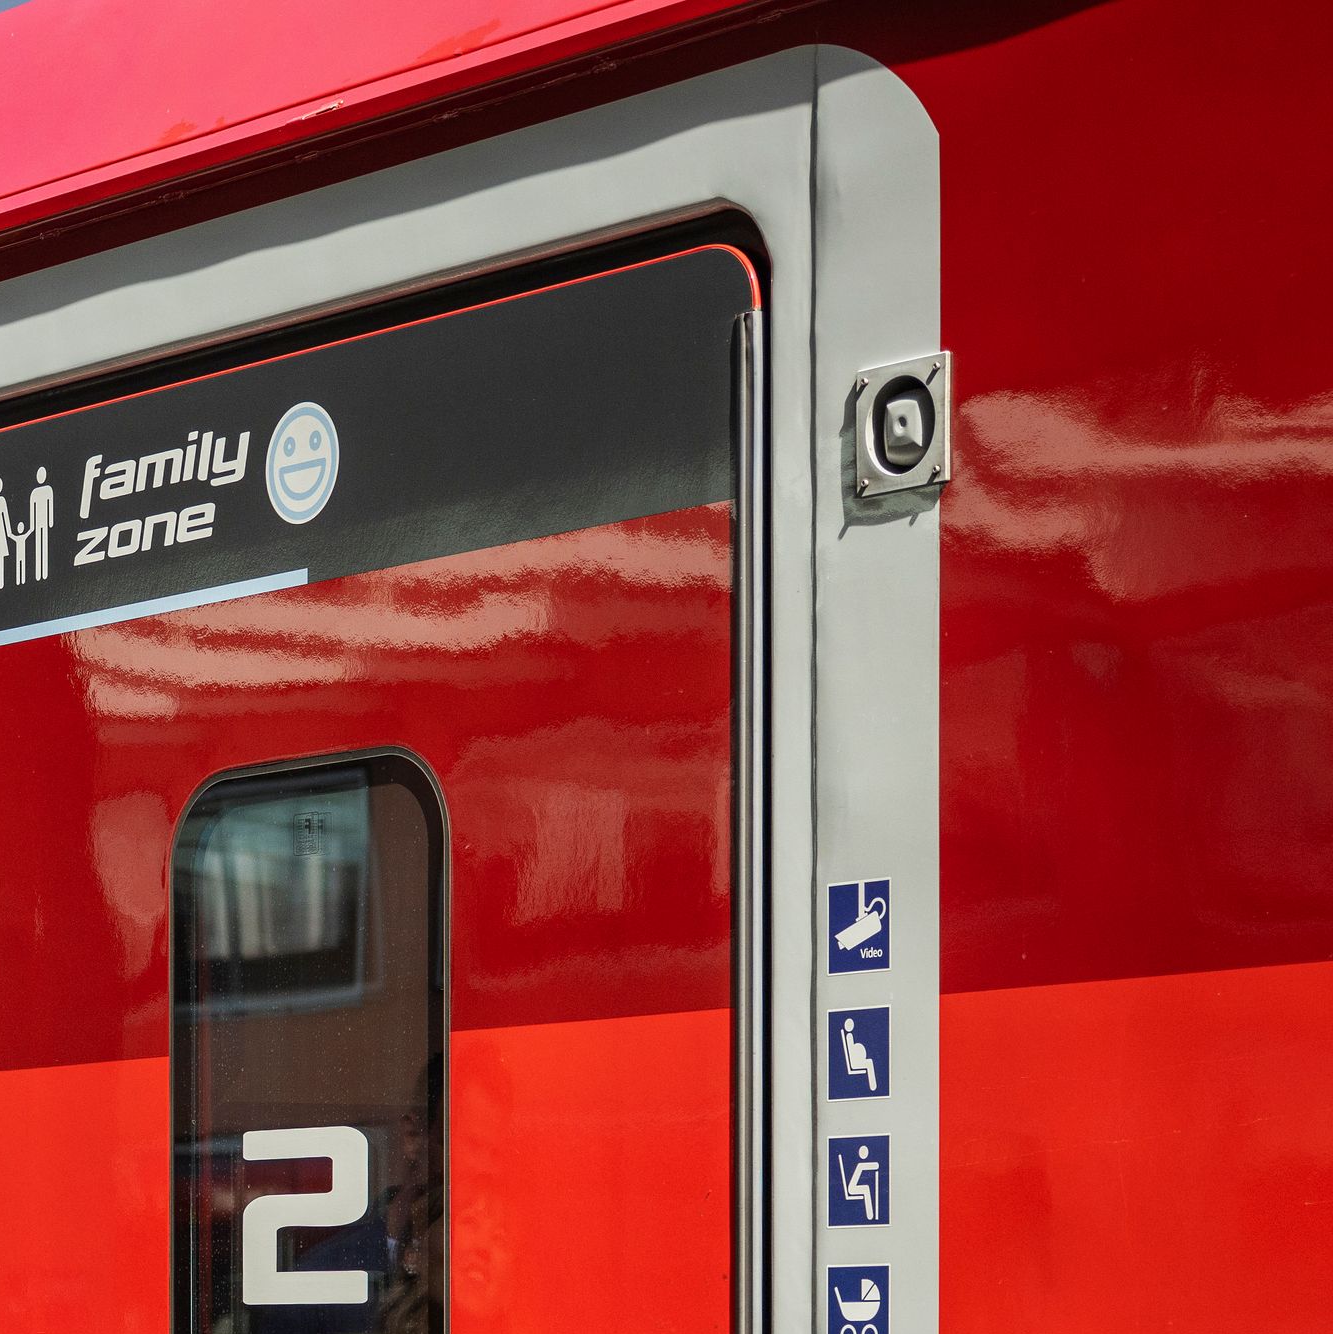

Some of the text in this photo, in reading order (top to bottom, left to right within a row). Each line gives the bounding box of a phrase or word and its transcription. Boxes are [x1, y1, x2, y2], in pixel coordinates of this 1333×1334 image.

[79, 430, 251, 520] family
[73, 502, 217, 567] zone
[859, 946, 884, 960] Video
[242, 1125, 369, 1306] 2
